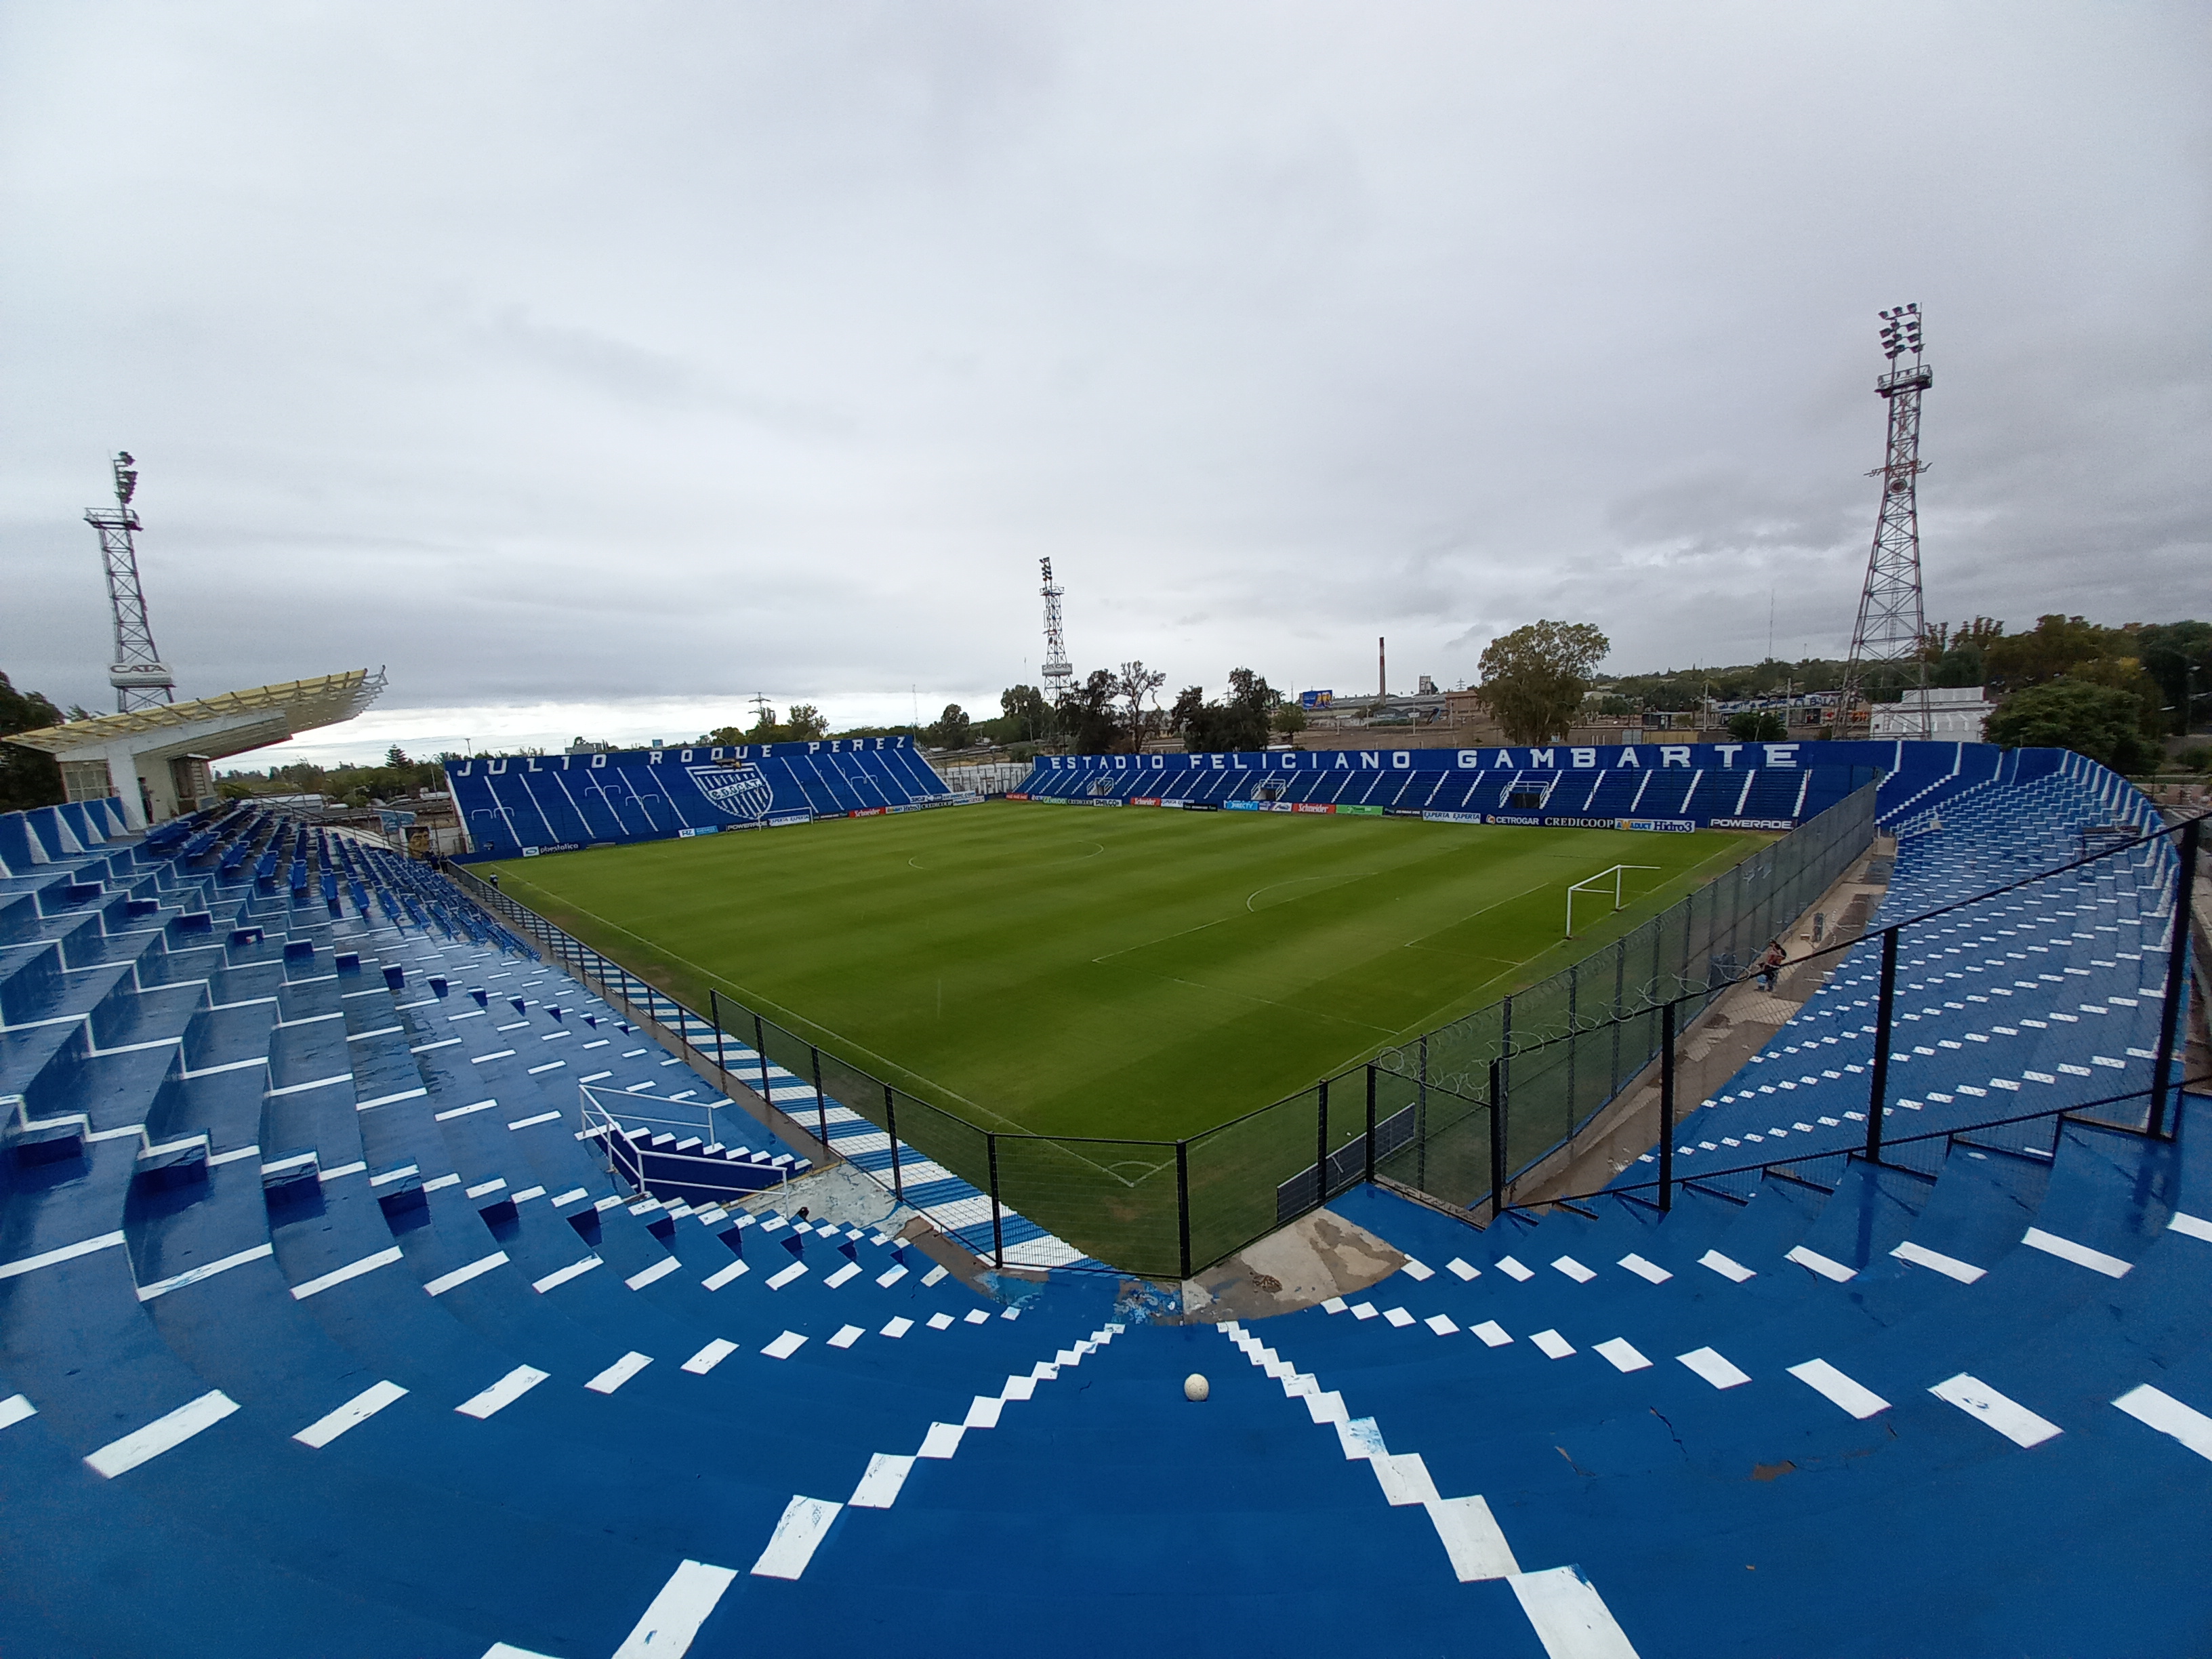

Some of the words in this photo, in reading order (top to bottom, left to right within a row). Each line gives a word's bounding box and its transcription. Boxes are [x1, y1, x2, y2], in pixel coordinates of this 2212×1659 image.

[110, 665, 167, 673] CATA
[457, 754, 607, 777] JULIO
[649, 744, 772, 764] ROQUE
[808, 736, 905, 754] PEREZ
[1051, 755, 1164, 769] ESTADIO
[1189, 752, 1410, 769] FELICIANO
[1457, 743, 1800, 769] GAMBARTE
[854, 808, 880, 817] Schneider
[1298, 803, 1329, 813] Schneider
[1452, 813, 1480, 821] EXPERTA
[1496, 816, 1540, 825] CETROGAR
[1544, 817, 1614, 827] CREDICOOP
[727, 820, 768, 830] POWERADE
[1653, 821, 1693, 832] Hidro3
[1710, 818, 1794, 830] POWERADE
